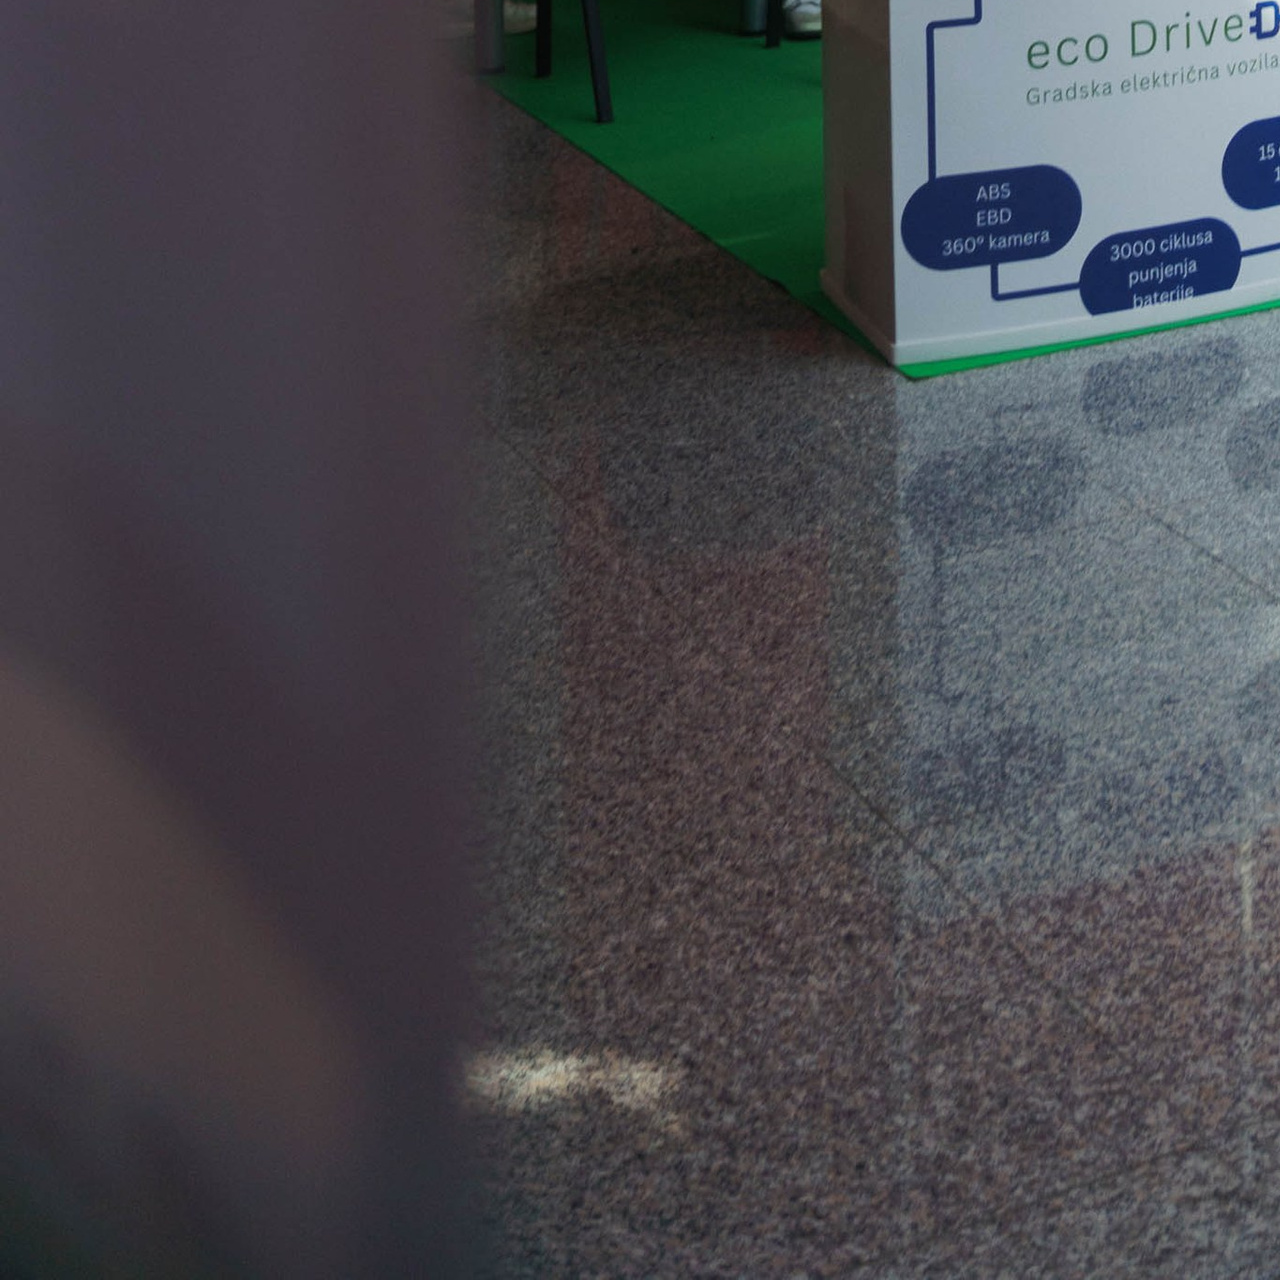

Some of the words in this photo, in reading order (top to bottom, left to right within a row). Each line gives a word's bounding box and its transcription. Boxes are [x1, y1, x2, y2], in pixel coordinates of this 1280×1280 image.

[1026, 32, 1109, 70] eco
[1130, 11, 1244, 58] Drive
[1026, 78, 1112, 107] Gradska
[1226, 52, 1280, 76] vozila
[1258, 142, 1275, 162] 15
[976, 182, 1011, 202] ABS
[976, 207, 1012, 227] EBD
[988, 229, 1050, 250] kamera
[1110, 238, 1156, 262] 3000
[1159, 230, 1213, 252] ciklusa
[1128, 256, 1198, 289] punjenja
